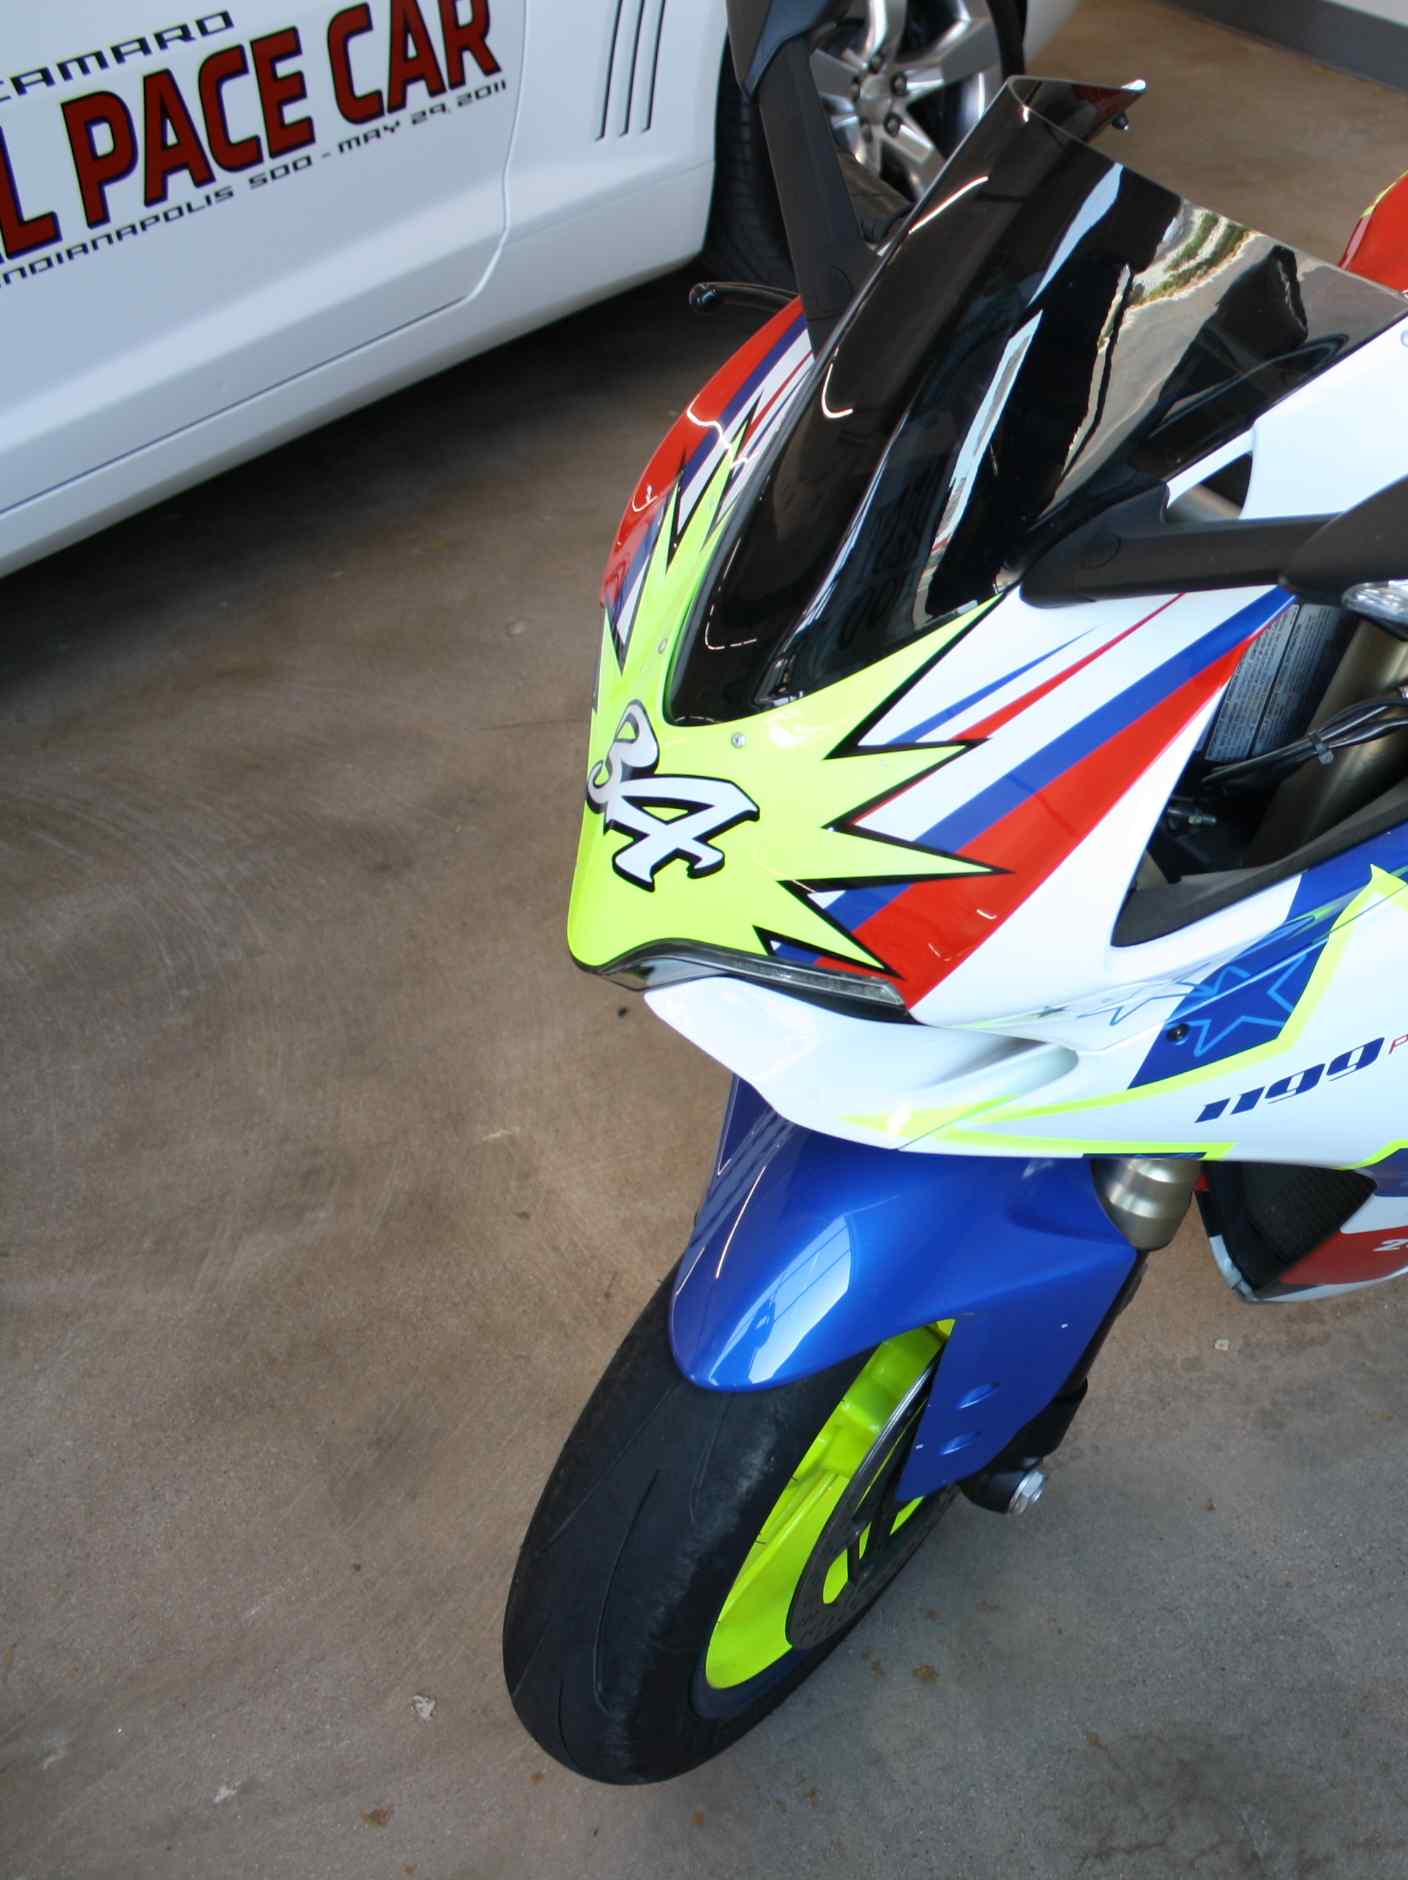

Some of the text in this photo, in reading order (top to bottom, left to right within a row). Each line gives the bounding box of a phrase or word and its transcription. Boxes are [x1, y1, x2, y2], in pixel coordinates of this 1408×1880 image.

[0, 10, 235, 101] AMARO
[60, 26, 317, 230] PACE
[326, 0, 502, 125] CAR
[0, 186, 235, 288] NDIANAPOLIS
[248, 154, 313, 190] 500
[337, 120, 401, 154] MAY
[457, 79, 507, 107] 2011
[1194, 1036, 1386, 1124] 1199
